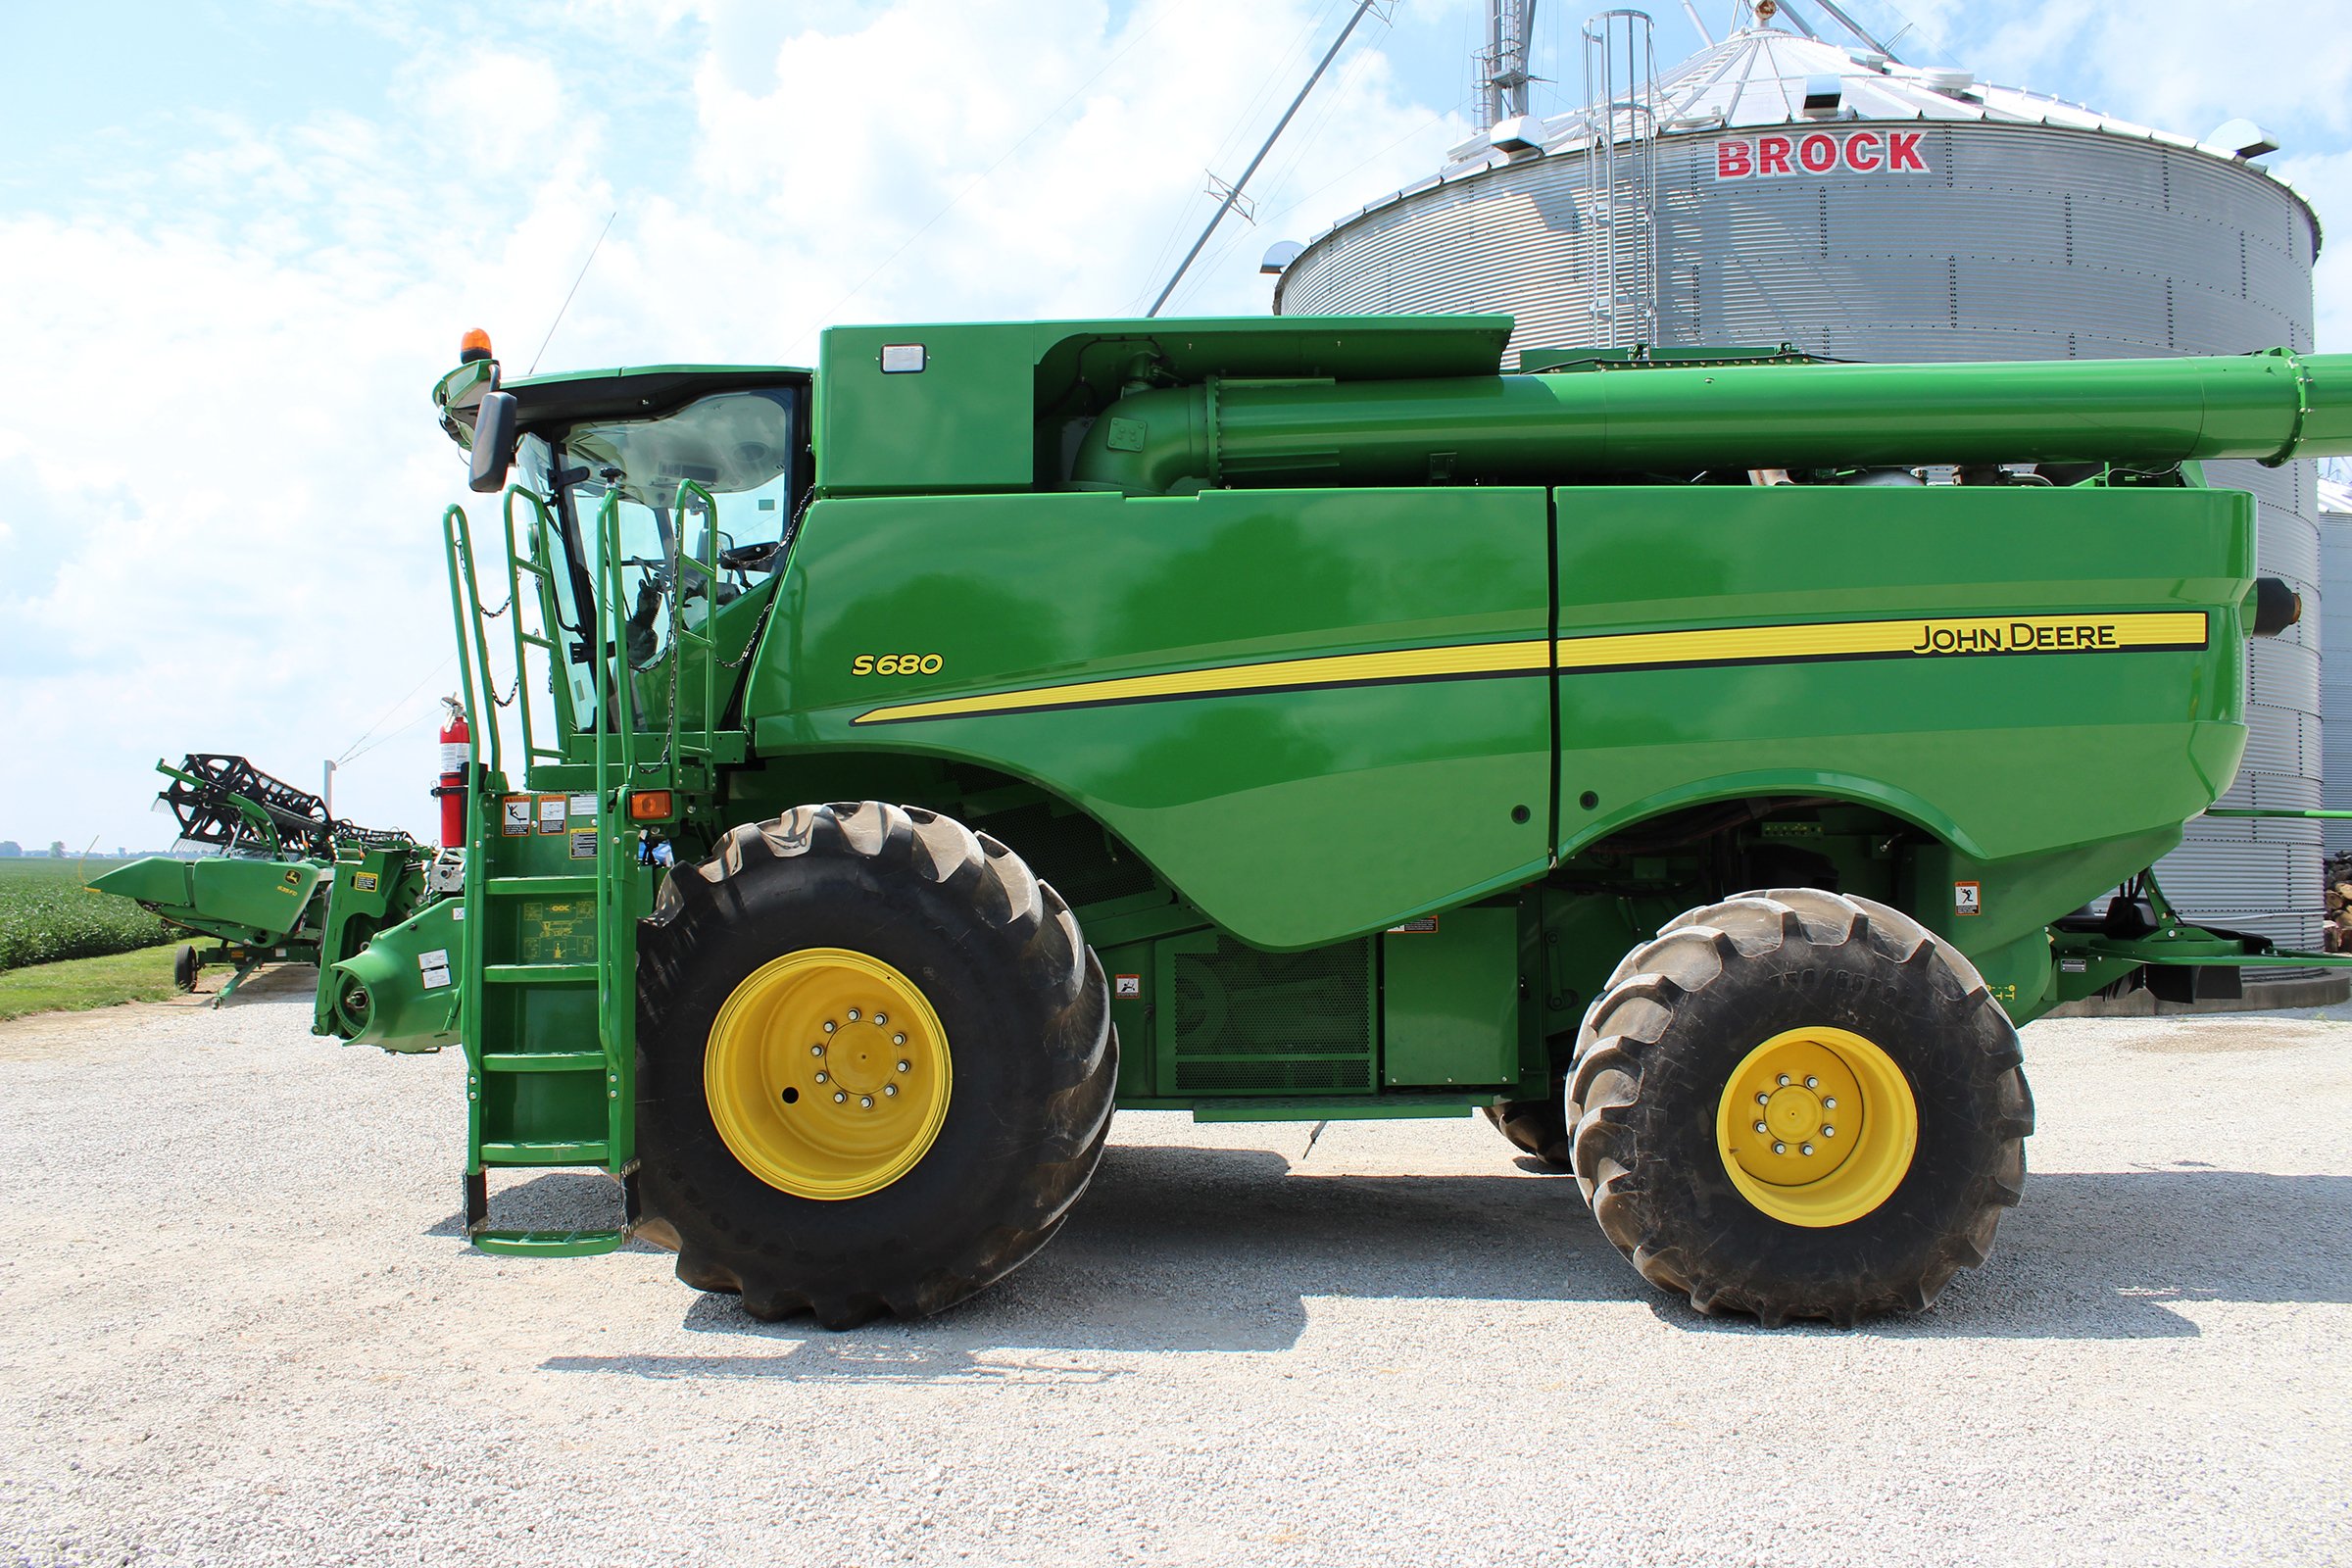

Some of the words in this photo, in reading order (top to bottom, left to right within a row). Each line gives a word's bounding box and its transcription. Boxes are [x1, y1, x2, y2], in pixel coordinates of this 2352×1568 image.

[1716, 129, 1931, 180] BROCK
[1913, 624, 2001, 651] JOHN
[2010, 622, 2117, 648] DEERE
[852, 653, 944, 676] S680
